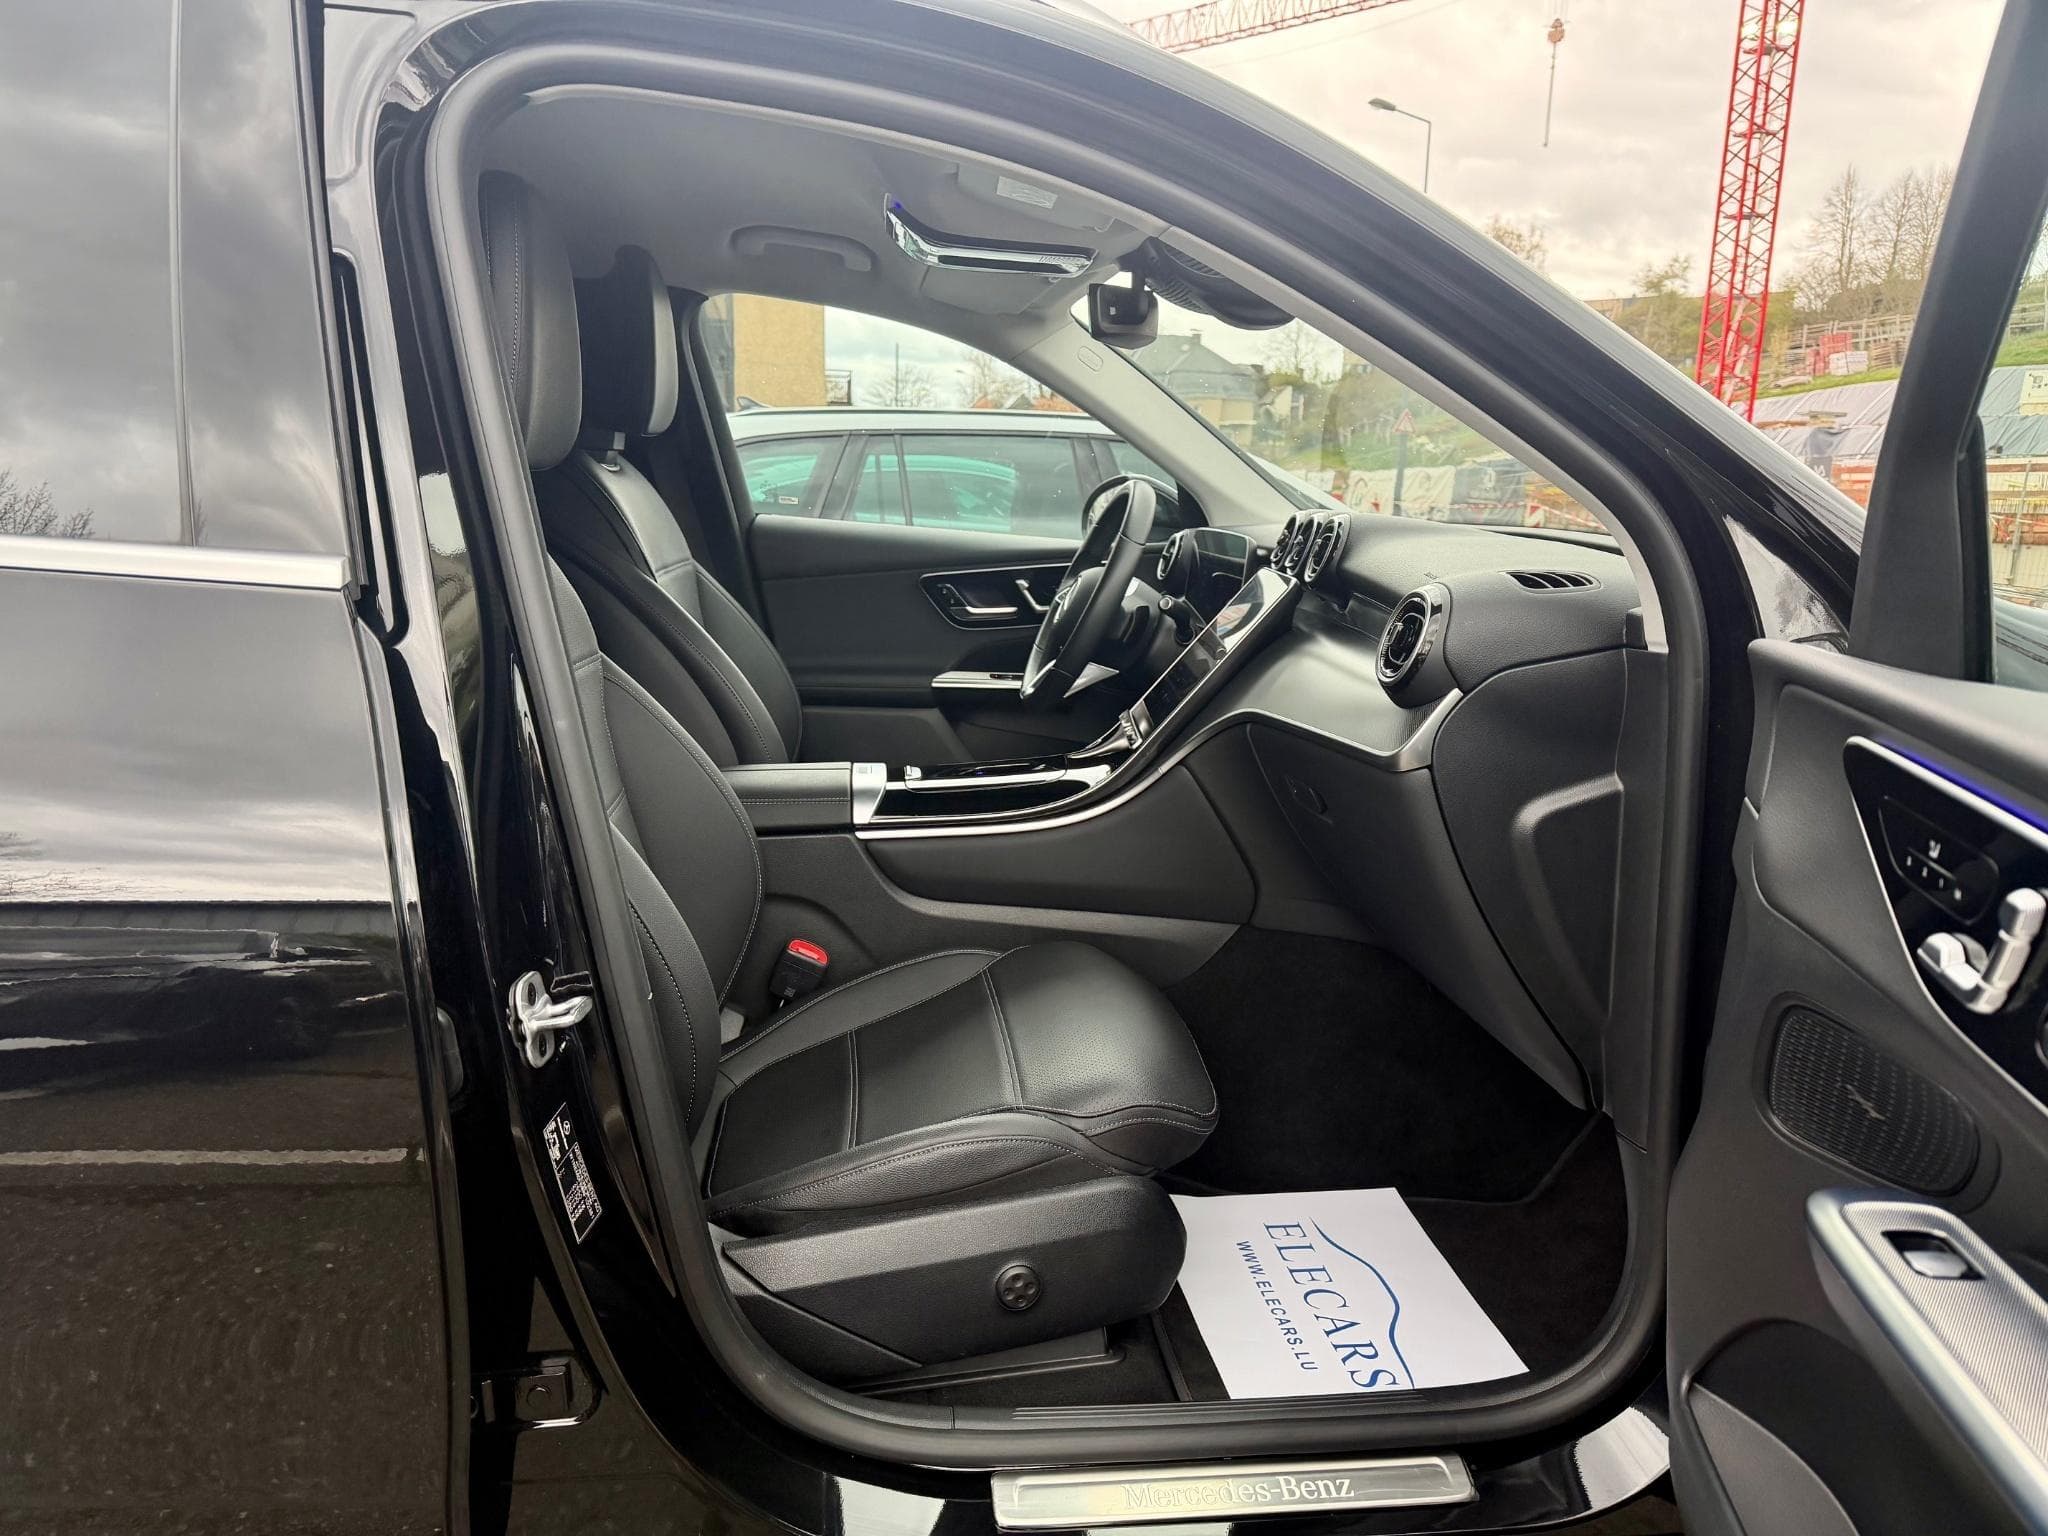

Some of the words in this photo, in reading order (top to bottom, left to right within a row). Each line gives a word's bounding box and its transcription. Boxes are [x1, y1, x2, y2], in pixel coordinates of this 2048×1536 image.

[1236, 1240, 1318, 1371] WWW.ELECARS.LU
[1263, 1221, 1400, 1389] ELECARS
[1121, 1475, 1354, 1509] Mercedes-Benz
